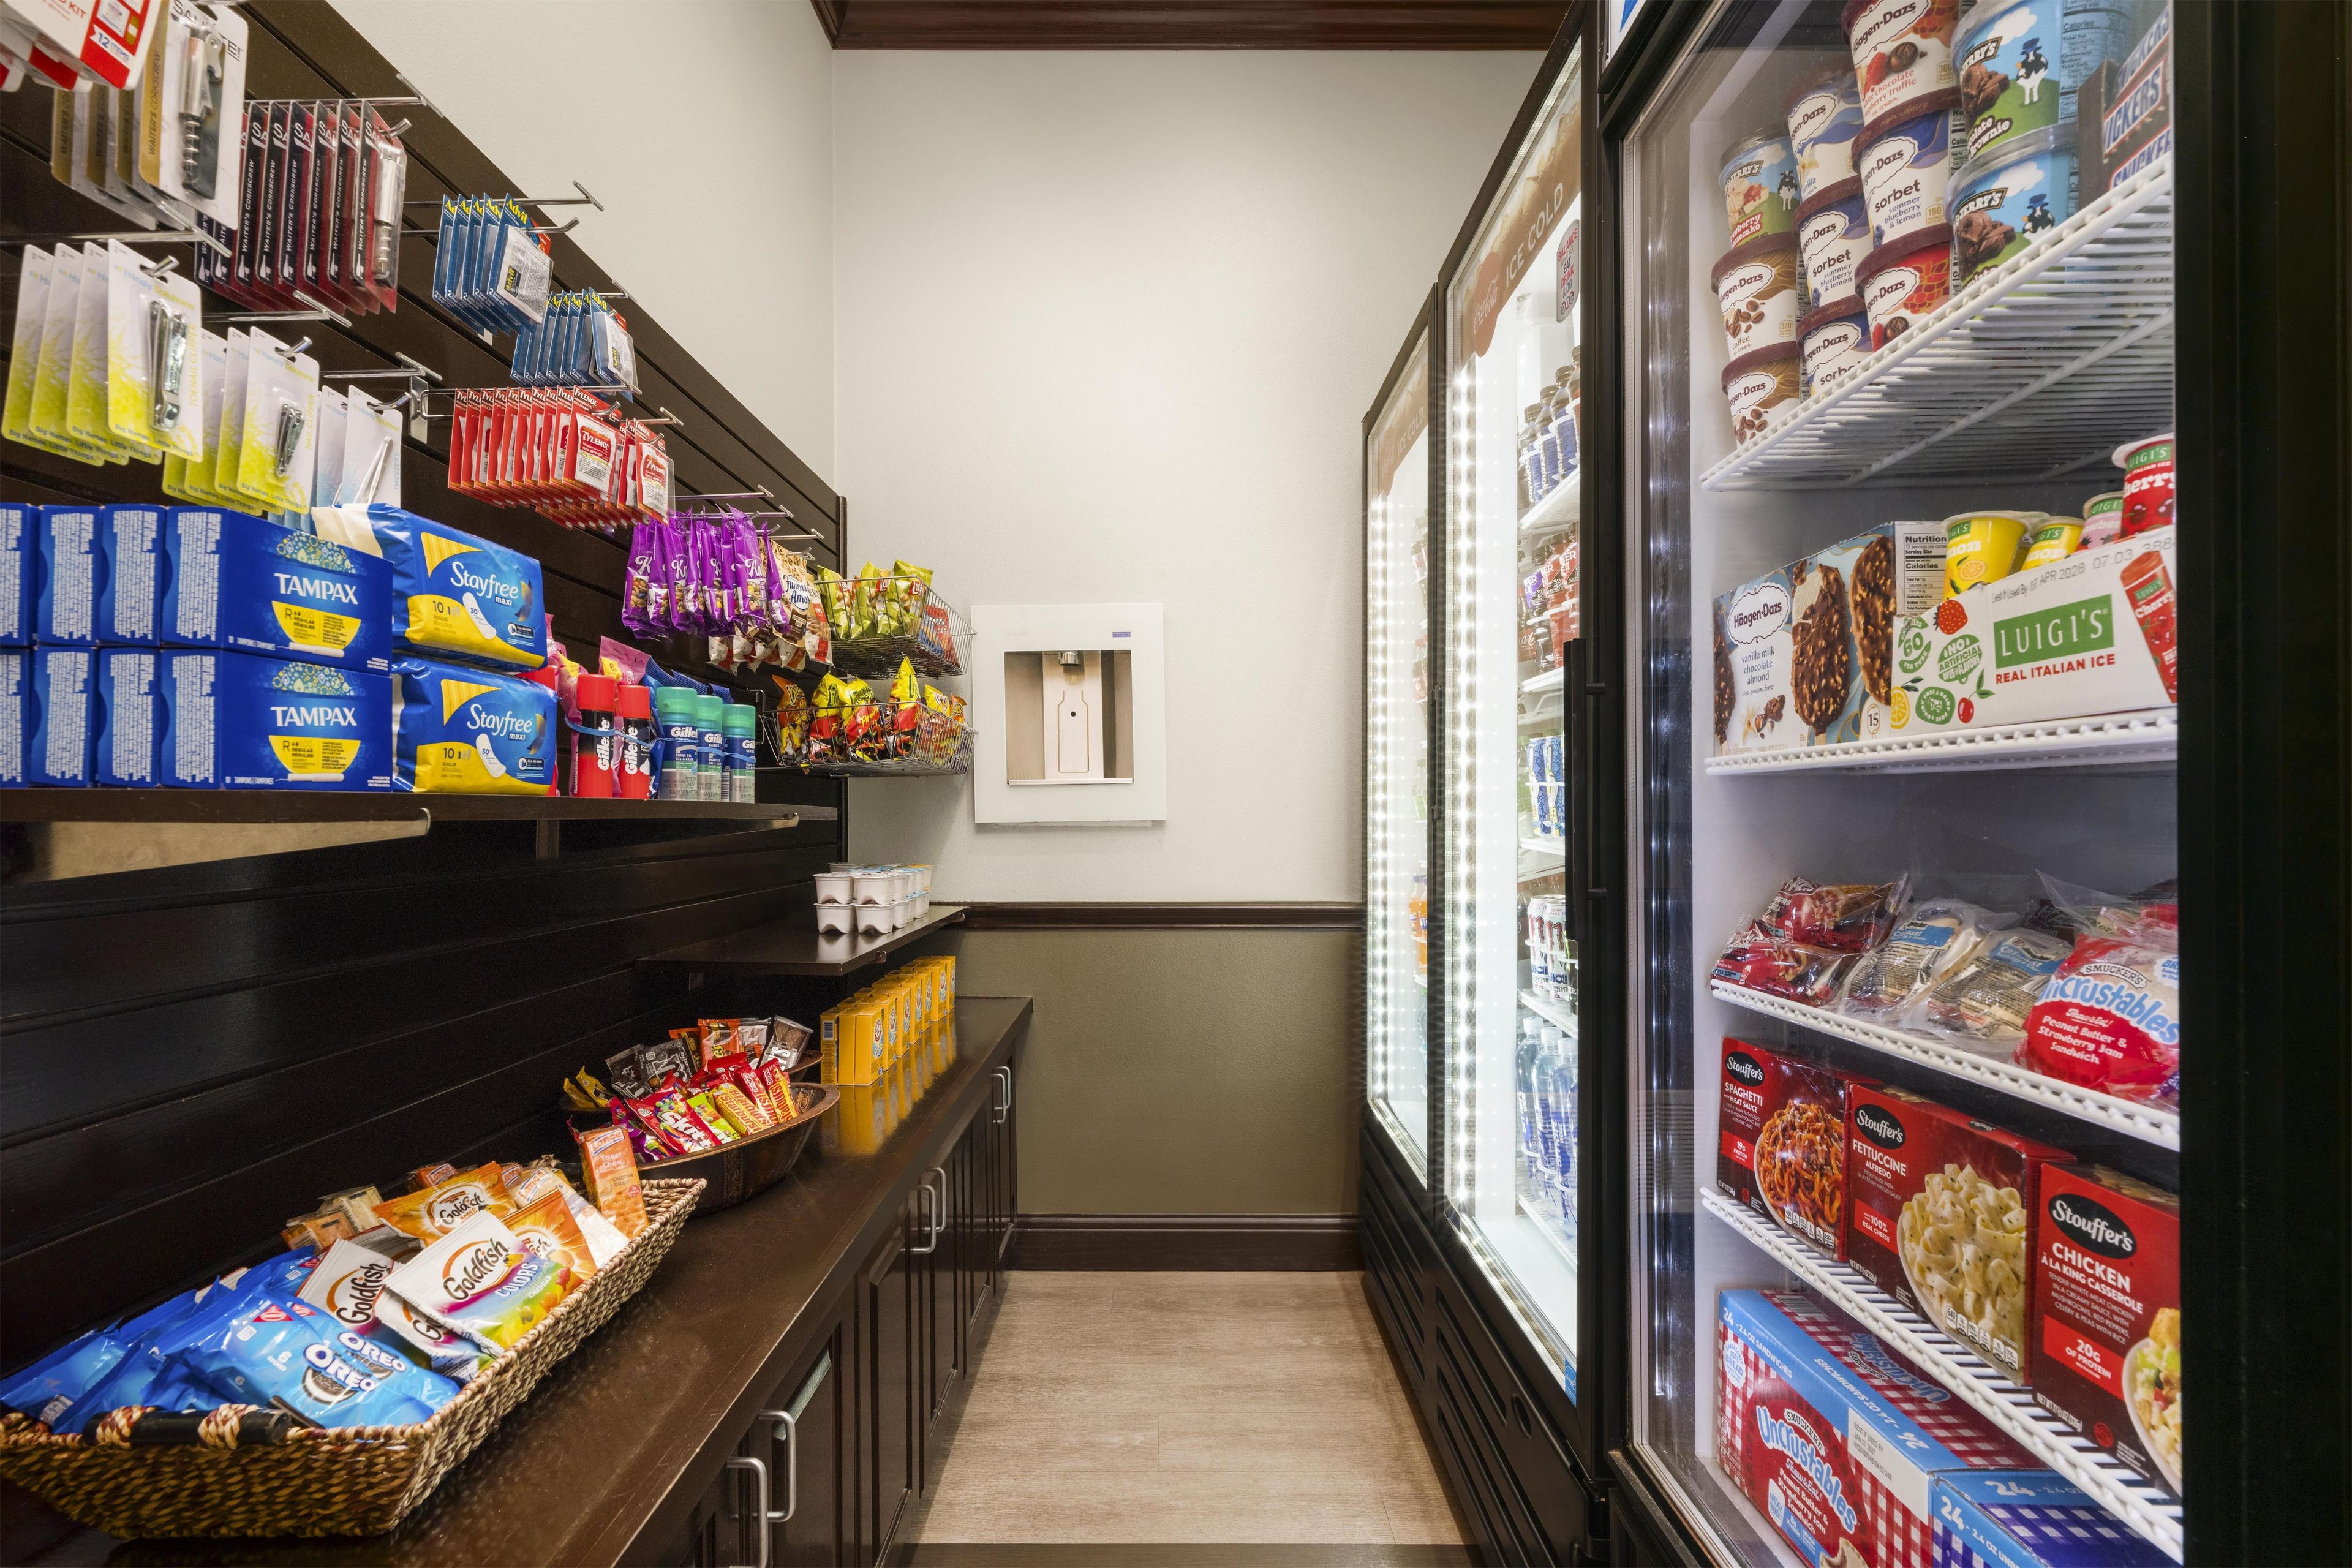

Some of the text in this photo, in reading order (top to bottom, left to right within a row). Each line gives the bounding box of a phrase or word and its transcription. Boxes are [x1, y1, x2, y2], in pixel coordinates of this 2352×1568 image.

[69, 3, 87, 18] KIT
[97, 32, 131, 61] 12 ITEMS
[1875, 69, 1915, 96] chocolate
[1888, 78, 1917, 95] truffle
[148, 111, 158, 156] WAITER'S
[242, 159, 254, 252] WAITER'S CORKSCREW
[1875, 179, 1921, 213] sorbet
[1888, 195, 1921, 213] summer
[506, 198, 528, 225] Advil
[1884, 203, 1921, 224] blueberry
[1896, 211, 1921, 225] lemon
[1928, 206, 1942, 216] 190
[1506, 182, 1564, 288] ICE COLD
[1558, 227, 1578, 262] BALANCE
[1812, 249, 1852, 277] sorbet
[1824, 263, 1852, 279] summer
[1561, 264, 1574, 290] DRINK
[1566, 279, 1572, 293] DO
[1820, 270, 1853, 288] blueberry
[1831, 277, 1853, 290] lemon
[124, 268, 195, 311] Handy Solutions
[592, 290, 607, 311] Advil
[1732, 336, 1750, 351] coffee
[261, 351, 315, 383] Handy Solutions
[574, 386, 598, 407] TYLENOL
[114, 423, 128, 433] Big
[635, 419, 650, 437] TYLENOL
[1408, 407, 1425, 441] COLD
[581, 431, 609, 451] TYLENOL
[2132, 464, 2157, 476] ITALIAN
[450, 560, 519, 600] Stayfree
[2040, 562, 2086, 586] APR 2028
[273, 572, 359, 605] TAMPAX
[789, 590, 810, 605] Amos
[2136, 579, 2164, 600] LUIGI'S
[432, 600, 444, 614] 10
[495, 596, 513, 606] maxi
[792, 614, 807, 624] CHOCOLATE
[1733, 601, 1782, 628] Häagen-Dazs
[1903, 631, 1924, 658] 60
[2000, 608, 2103, 658] LUIGI'S
[1741, 645, 1776, 664] vanilla milk
[1903, 649, 1928, 669] PER TUBE
[1939, 644, 1983, 673] ARTIFICIAL
[1947, 638, 1966, 658] NO
[1743, 660, 1773, 674] chocolate
[1747, 671, 1770, 685] almond
[1943, 655, 1981, 681] DYES FLAVORS
[1996, 653, 2116, 685] REAL ITALIAN ICE
[1748, 684, 1774, 695] cream bars
[1923, 688, 1951, 712] FREE DAIRY
[270, 706, 358, 728] TAMPAX
[467, 703, 533, 737] Stayfree
[1868, 712, 1879, 727] 15
[508, 732, 526, 741] maxi
[443, 747, 455, 760] 10
[2085, 965, 2144, 986] SMUCKER'S
[2037, 1026, 2124, 1060] Strawberry Jam
[2042, 1015, 2128, 1049] Peanut Butter &
[2049, 1041, 2101, 1065] Sandwich
[1727, 1056, 1765, 1082] Stouffer's
[1724, 1082, 1763, 1107] SPAGHETTI
[1729, 1095, 1758, 1114] MEAT SAUCE
[1856, 1109, 1904, 1144] Stouffer's
[590, 1130, 624, 1152] Lance
[1736, 1140, 1746, 1152] 19G
[601, 1152, 623, 1161] Toast
[602, 1159, 624, 1168] Chee
[1733, 1147, 1748, 1160] PROTEIN
[1852, 1138, 1907, 1177] FETTUCCINE
[429, 1165, 454, 1183] Lance
[612, 1173, 635, 1182] CHEDDAR
[1865, 1160, 1892, 1180] ALFREDO
[459, 1207, 477, 1221] BAKED
[1870, 1214, 1888, 1233] 100%
[2052, 1200, 2134, 1252] Stouffer's
[1861, 1221, 1891, 1243] REAL CHEESE
[443, 1237, 510, 1302] Goldfish
[494, 1262, 540, 1298] COLORS
[2052, 1242, 2131, 1294] CHICKEN
[335, 1263, 388, 1324] Goldfish
[527, 1275, 553, 1300] CHEDDAR
[2041, 1251, 2144, 1315] À LA KING CASSEROLE
[2048, 1272, 2135, 1321] TENDER WHITE MEAT CHICKEN
[337, 1331, 407, 1373] OREO
[1722, 1307, 1793, 1378] 24 OZ SANDWICHES
[2076, 1339, 2101, 1363] 20G
[304, 1343, 376, 1392] OREO
[1725, 1355, 1744, 1376] BREAD
[2065, 1347, 2111, 1379] OF PROTEIN
[1786, 1411, 1823, 1452] SMUCKER'S
[1756, 1405, 1856, 1533] Uncrustables
[1779, 1468, 1828, 1526] Peanut Butter &
[1984, 1480, 2036, 1496] 24
[1777, 1477, 1826, 1535] Strawberry Jam
[1787, 1498, 1816, 1535] Sandwich
[1940, 1495, 1965, 1531] 24
